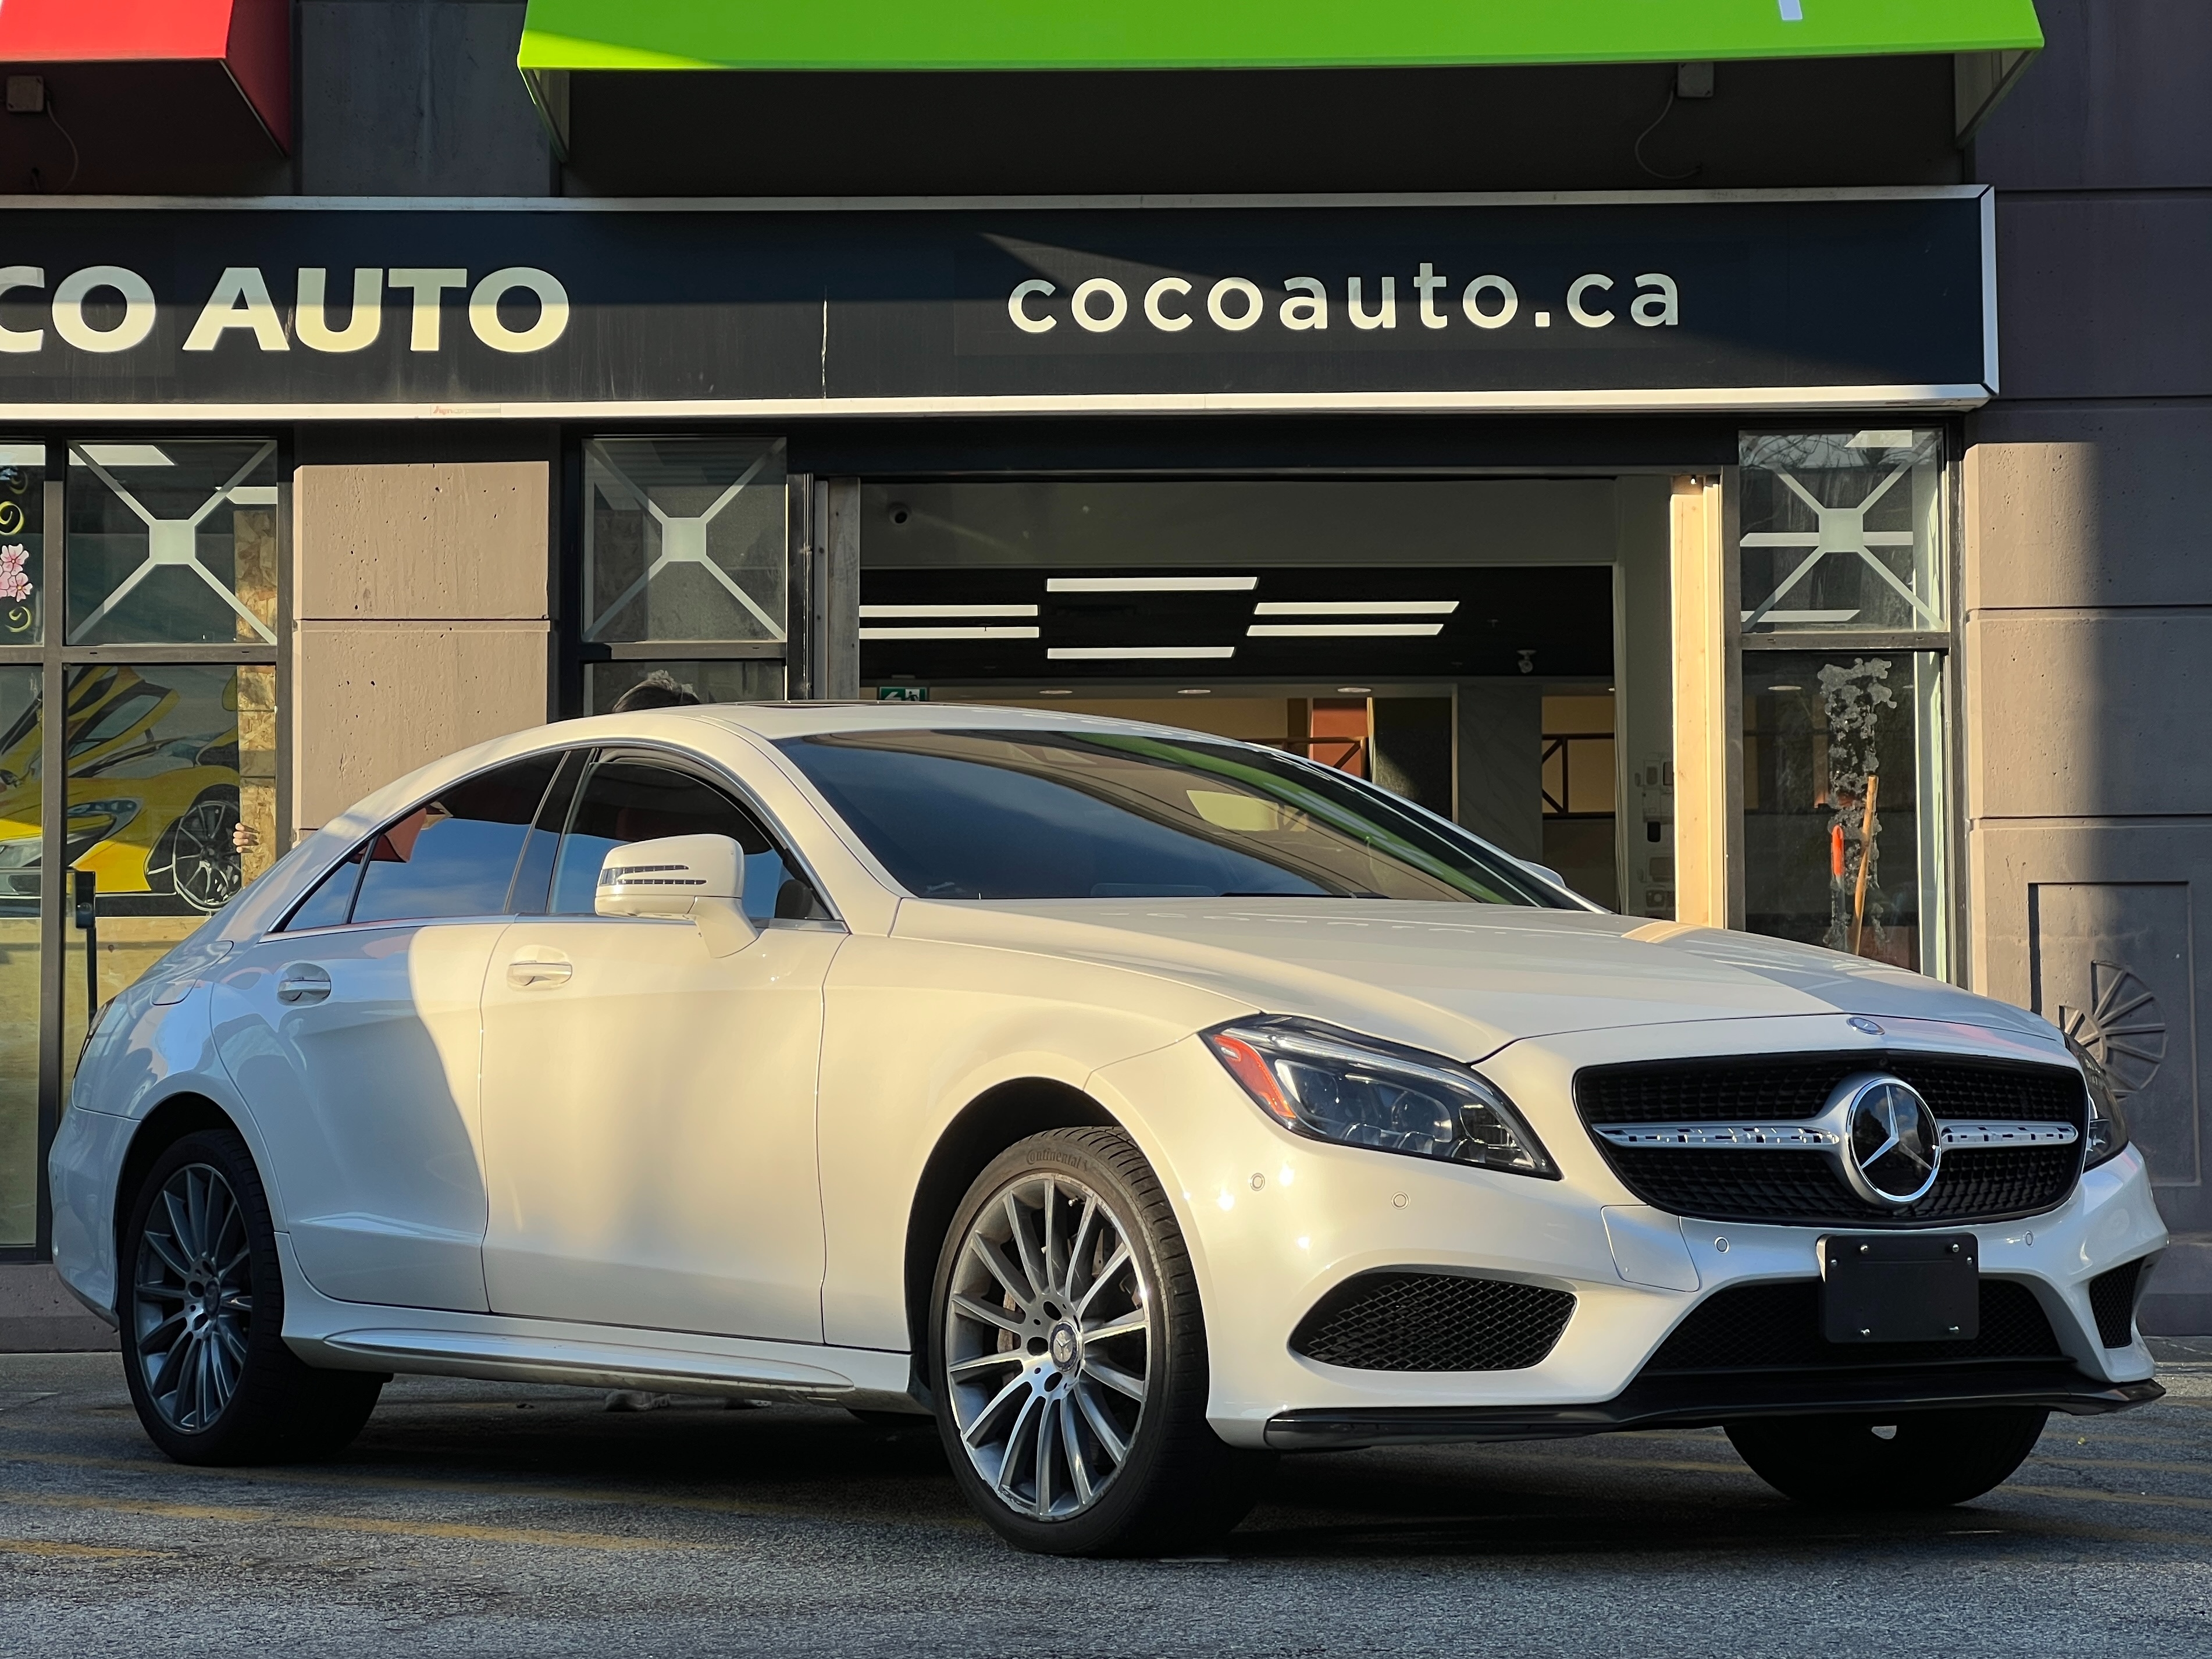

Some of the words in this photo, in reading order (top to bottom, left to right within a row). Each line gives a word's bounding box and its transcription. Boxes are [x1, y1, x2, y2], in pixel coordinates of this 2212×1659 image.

[182, 266, 570, 354] AUTO
[1007, 262, 1679, 334] cocoauto.ca
[1027, 1148, 1082, 1169] Continental
